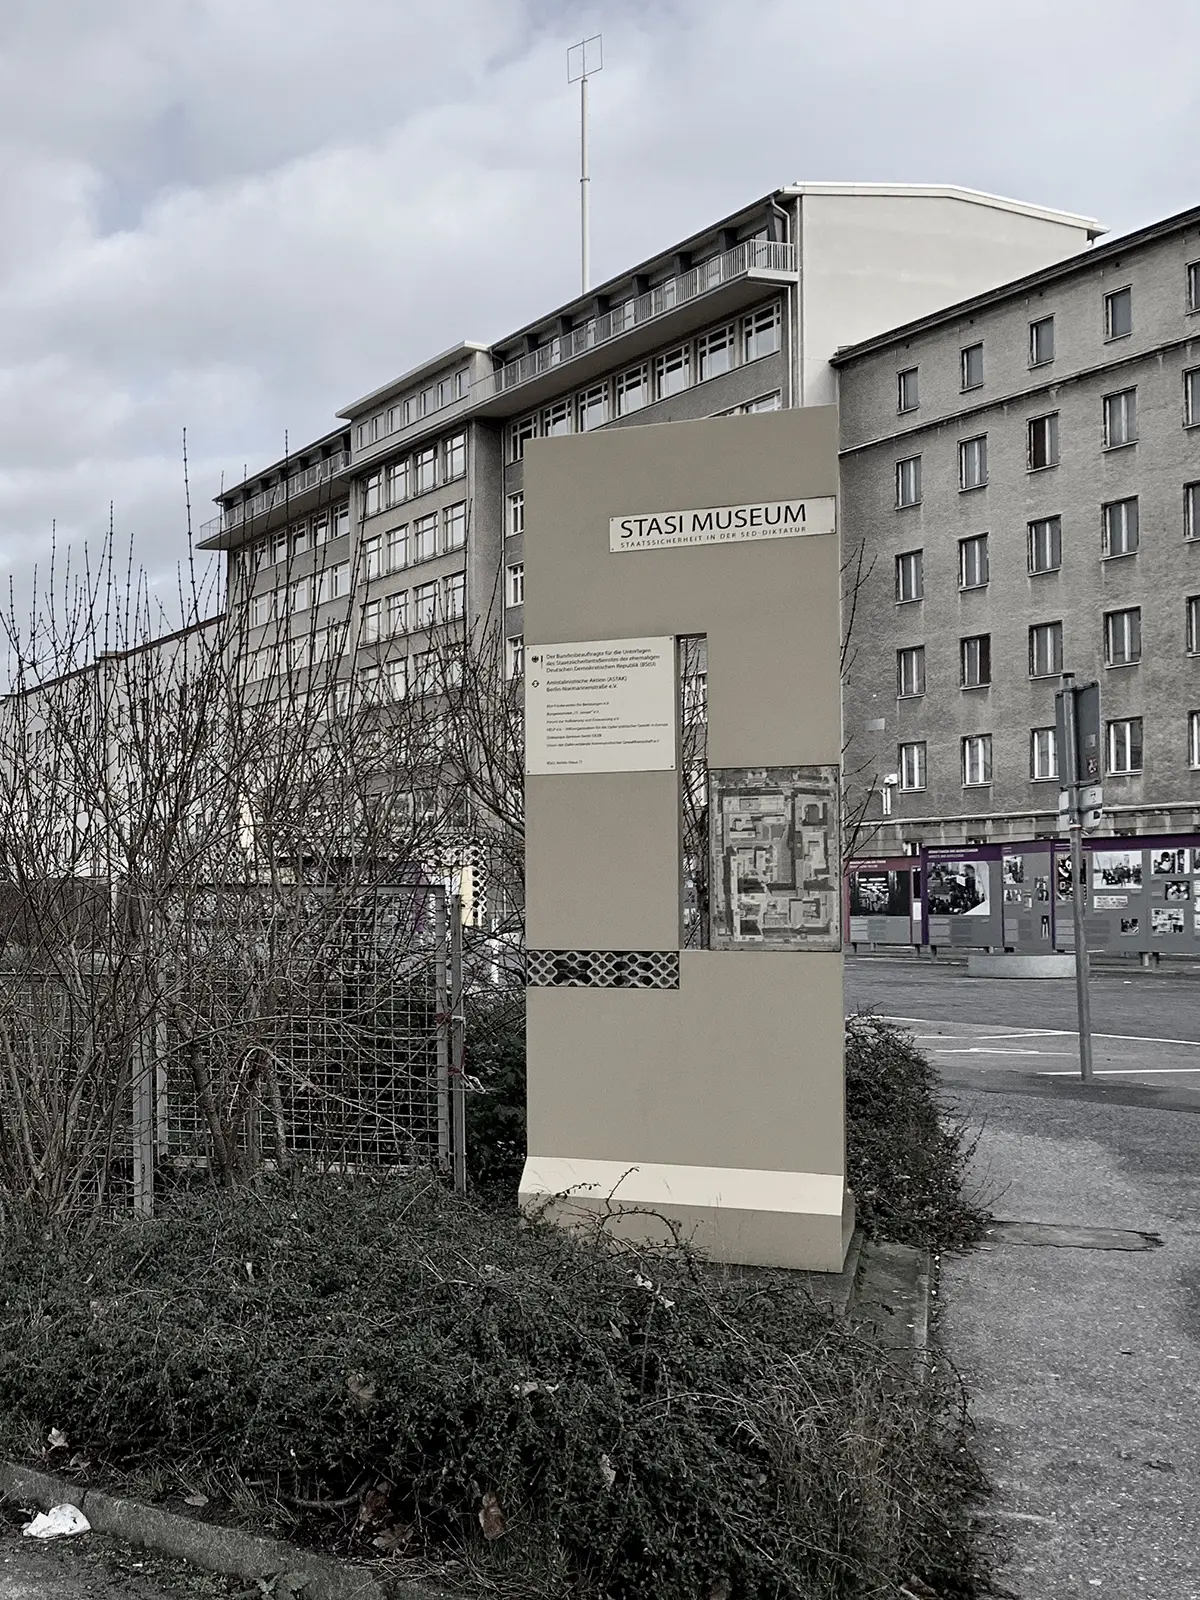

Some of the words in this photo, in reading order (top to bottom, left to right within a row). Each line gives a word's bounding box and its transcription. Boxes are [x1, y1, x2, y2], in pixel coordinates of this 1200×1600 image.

[620, 515, 683, 539] STASI
[692, 503, 807, 532] MUSEUM
[620, 535, 702, 549] STAATSSICHERHEIT
[719, 532, 737, 540] DER
[741, 526, 807, 538] SED-DIKTATUR
